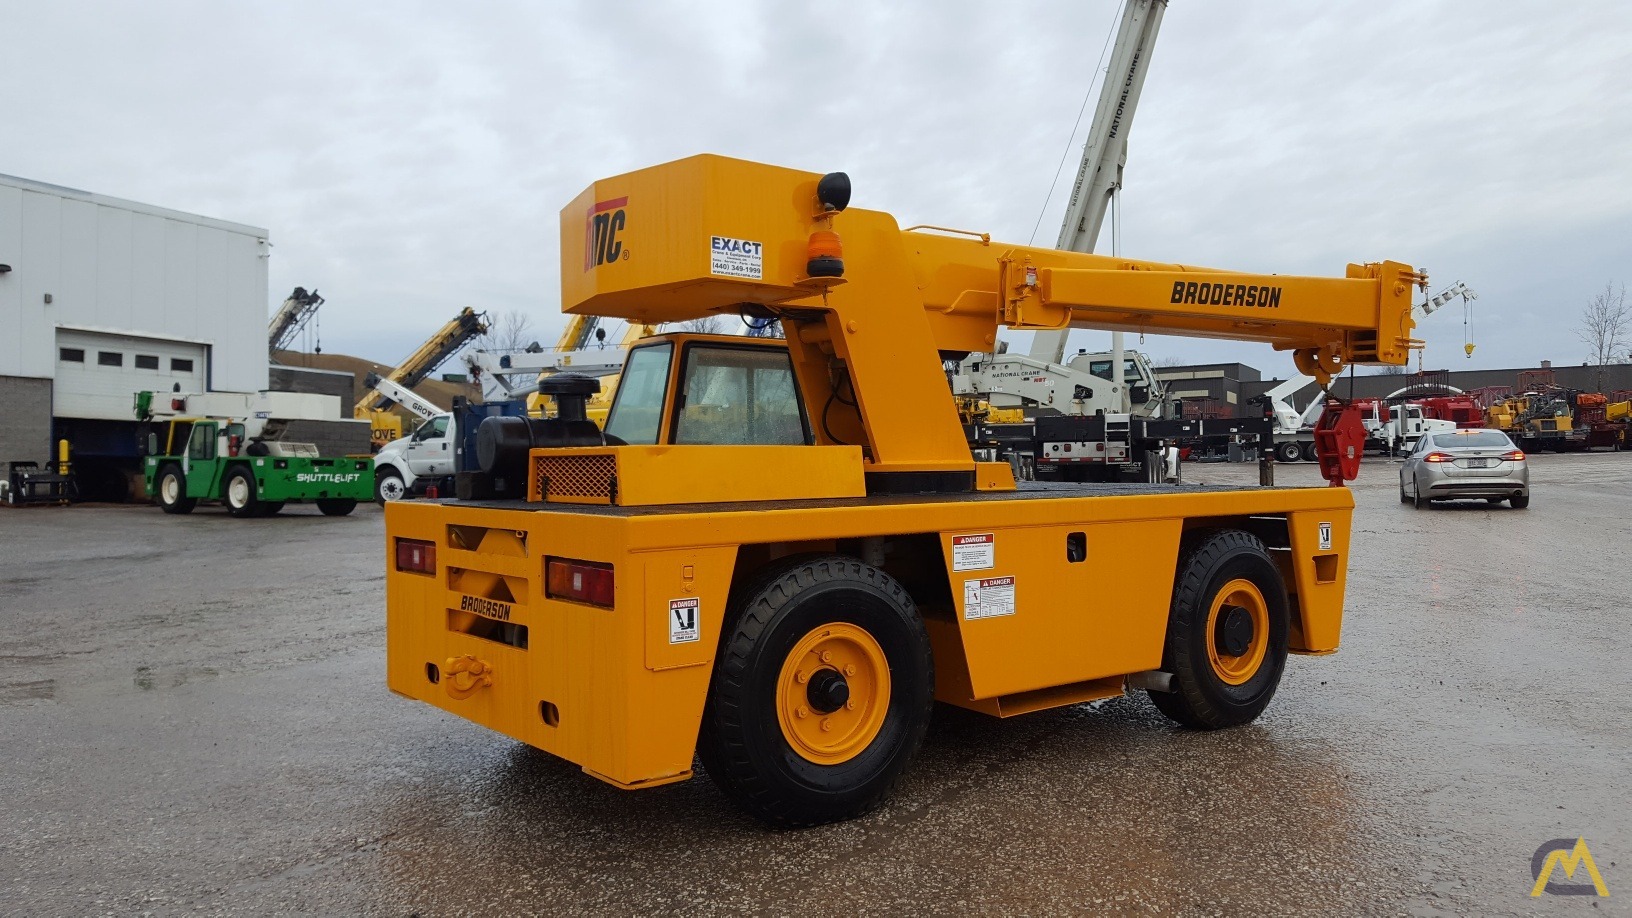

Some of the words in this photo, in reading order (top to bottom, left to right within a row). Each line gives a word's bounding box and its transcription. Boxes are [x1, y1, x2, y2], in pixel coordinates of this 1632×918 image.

[1109, 88, 1130, 139] NATIONAL
[1125, 53, 1140, 87] CRANE
[1072, 177, 1084, 207] NATIONAL
[711, 236, 762, 255] EXACT
[712, 262, 730, 270] (440)
[731, 264, 761, 274] 349-1999
[1170, 281, 1282, 308] BRODERSON
[296, 473, 360, 483] SHUTTLELIFT
[460, 595, 511, 621] BRODERSON
[677, 600, 697, 608] DANGER
